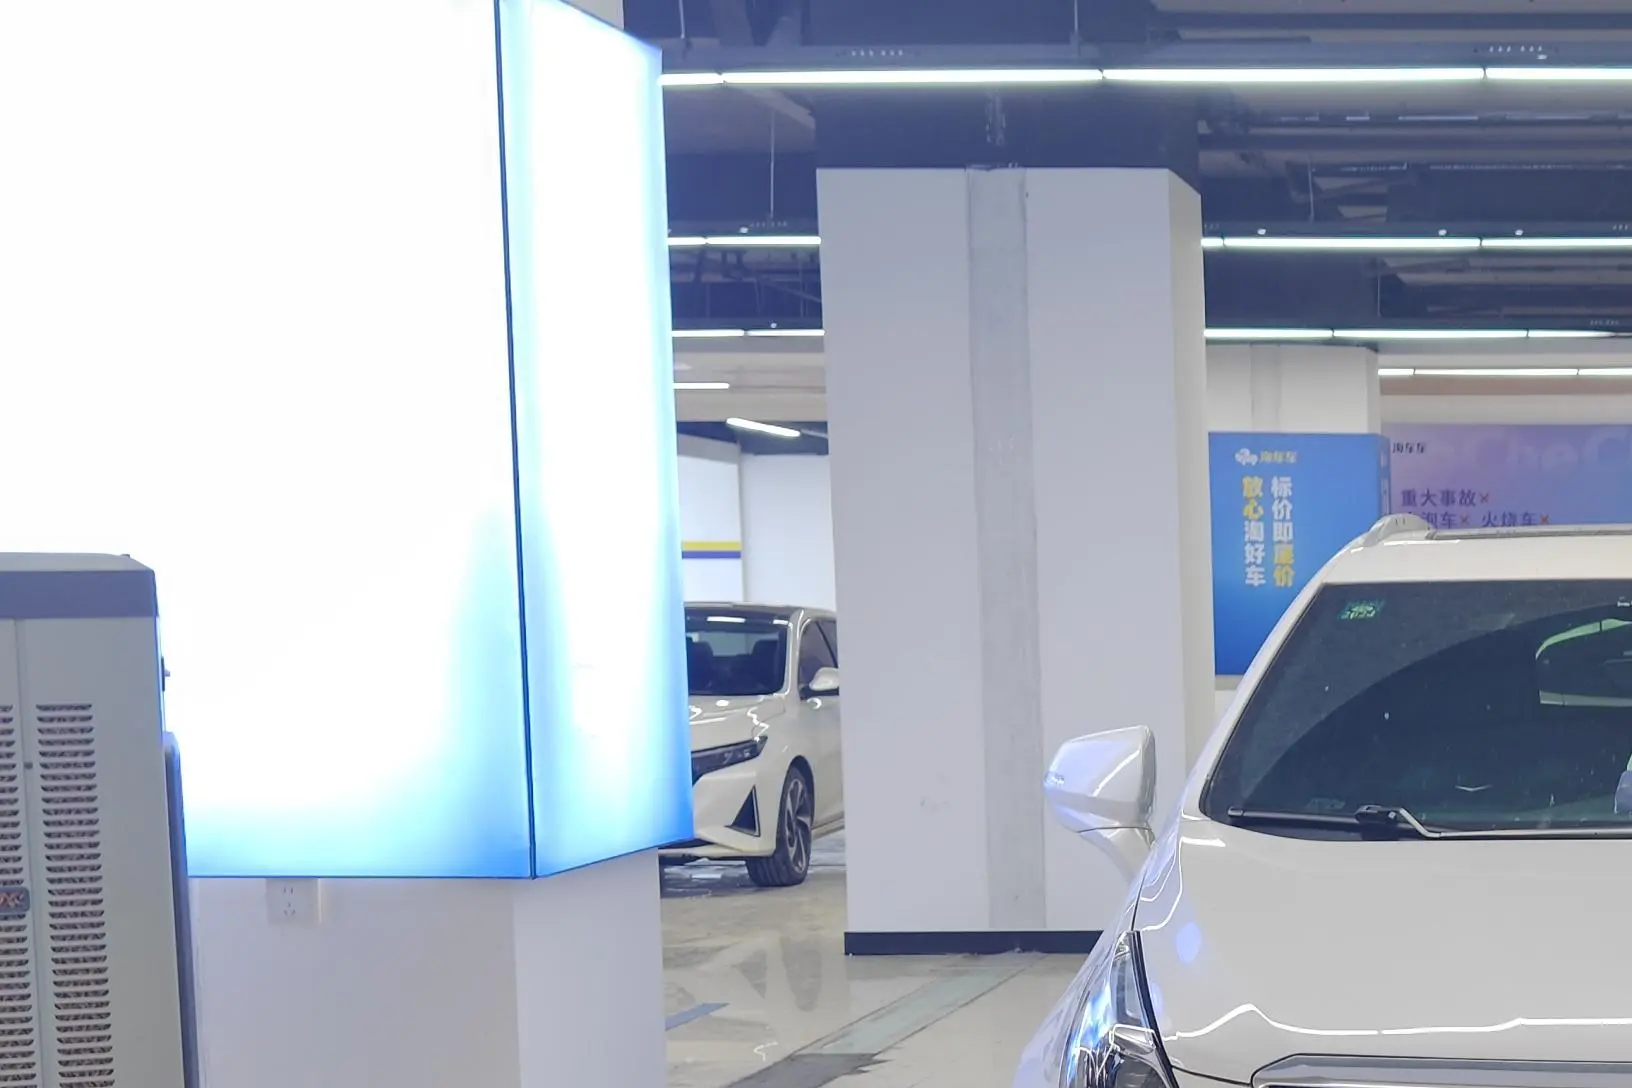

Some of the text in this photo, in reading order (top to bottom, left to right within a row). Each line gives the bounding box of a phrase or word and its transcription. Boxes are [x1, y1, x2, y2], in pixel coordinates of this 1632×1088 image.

[1242, 476, 1265, 587] 放心淘好车
